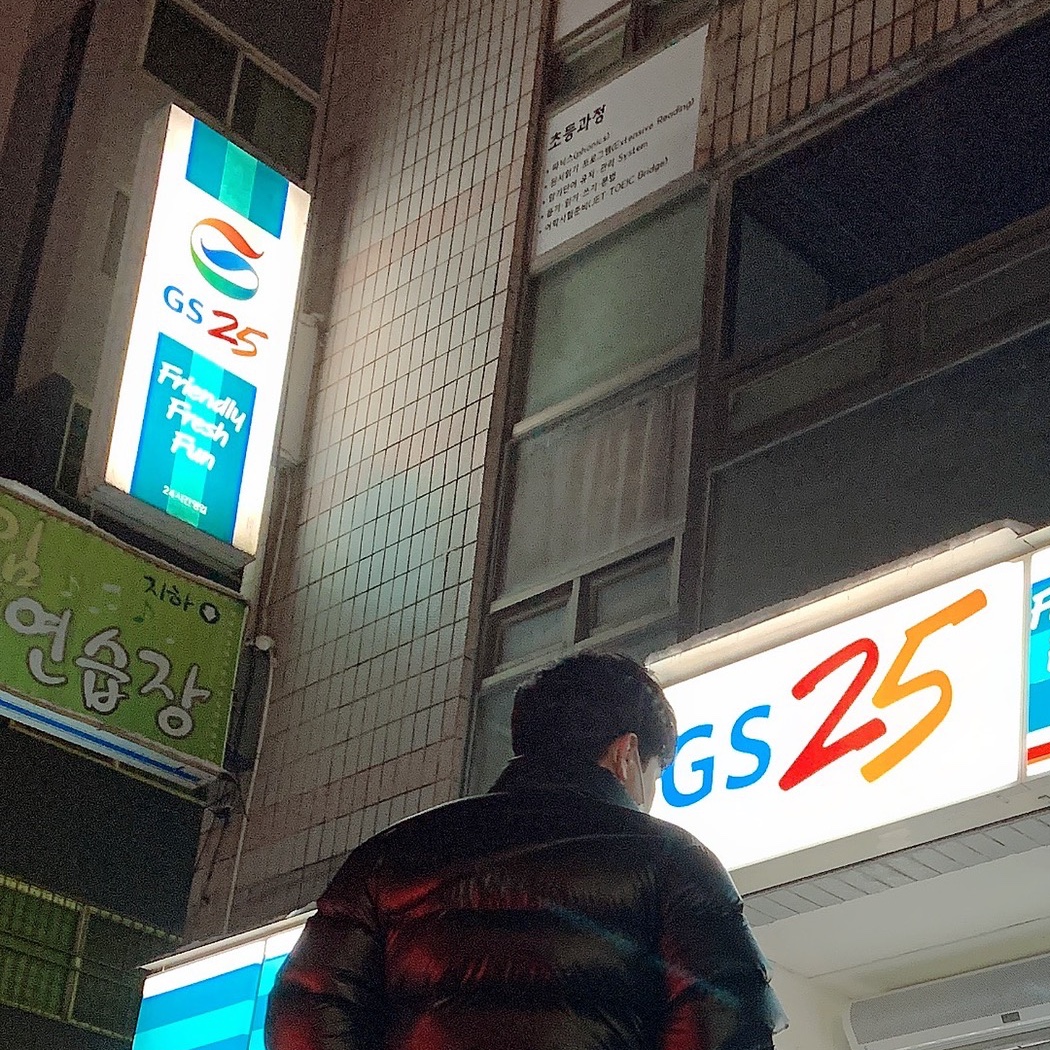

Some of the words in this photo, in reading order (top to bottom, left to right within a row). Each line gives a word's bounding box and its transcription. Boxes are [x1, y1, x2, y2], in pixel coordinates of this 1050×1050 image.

[548, 104, 606, 151] 초등과정
[656, 98, 695, 125] Reading)
[618, 141, 648, 163] System
[163, 285, 269, 357] GS25
[157, 361, 247, 433] Friendly
[165, 396, 230, 448] Fresh
[170, 430, 216, 471] Fun
[143, 575, 194, 612] 지하
[5, 597, 212, 738] 연습장
[660, 588, 988, 808] GS25
